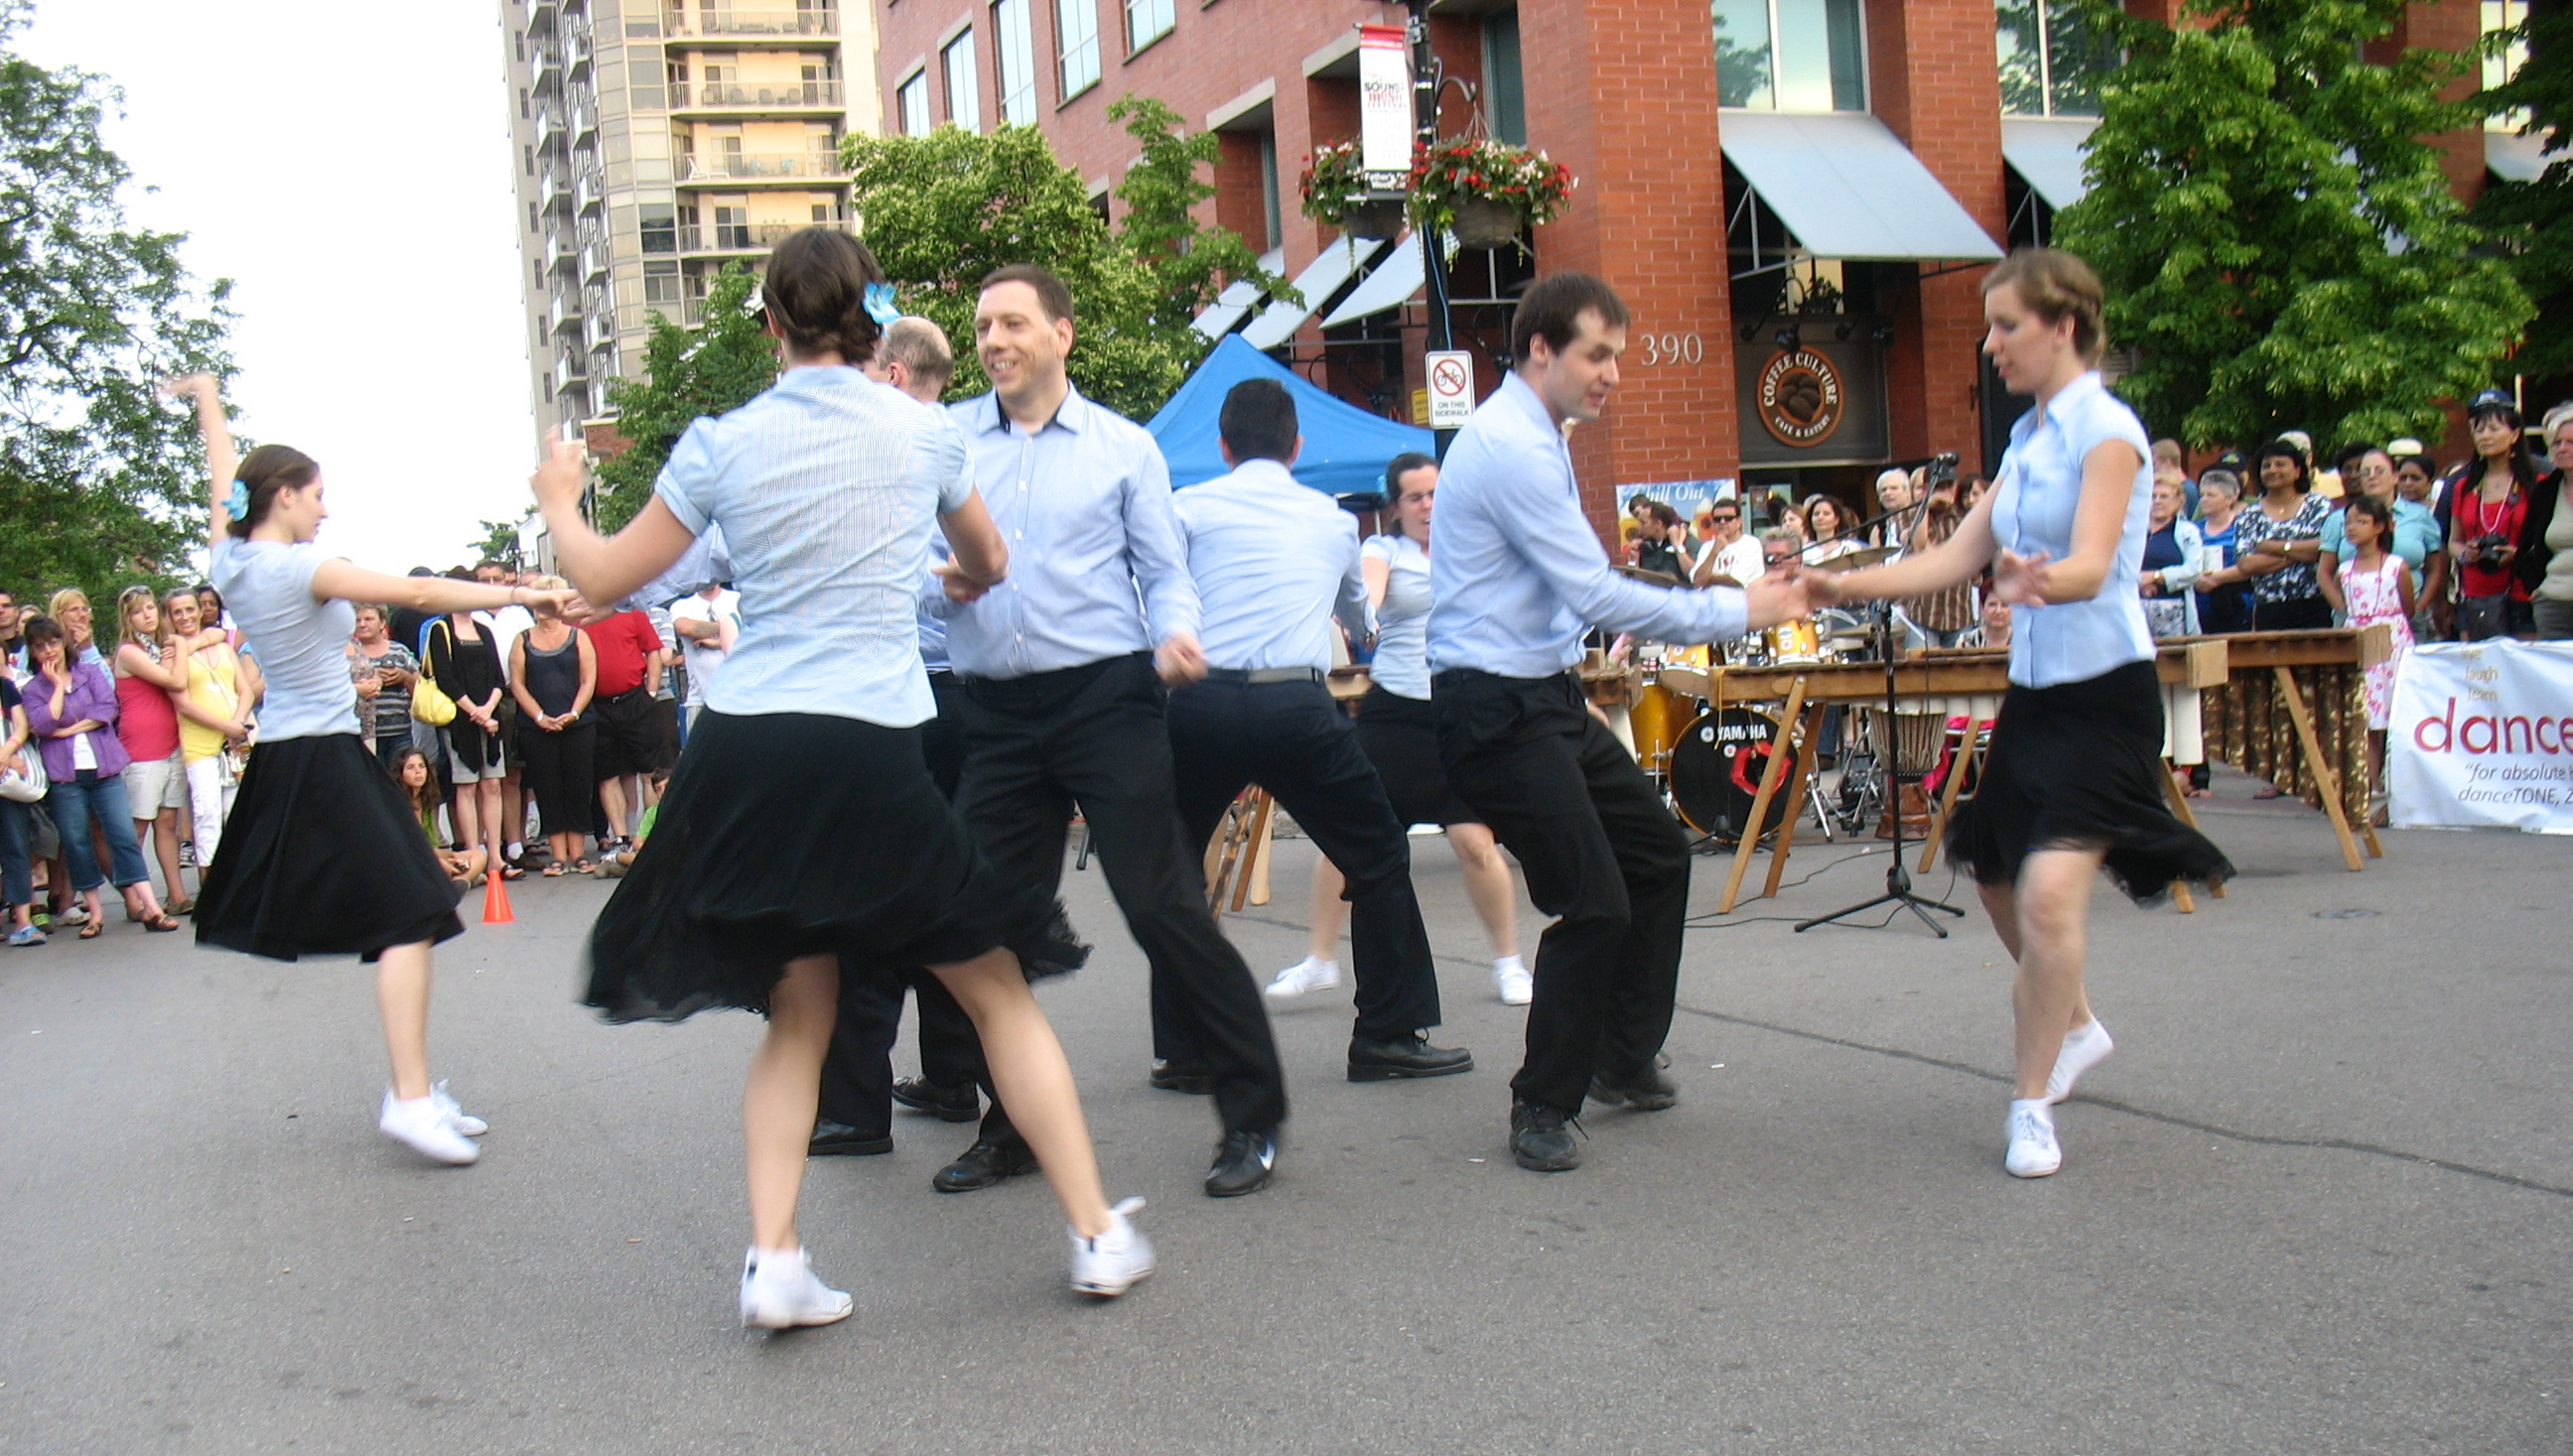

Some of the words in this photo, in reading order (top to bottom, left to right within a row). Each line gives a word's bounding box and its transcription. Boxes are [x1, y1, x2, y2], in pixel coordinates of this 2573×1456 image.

[1640, 333, 1702, 366] 390
[1763, 354, 1794, 407] COFFEE
[1795, 352, 1837, 405] CULTURE
[1675, 484, 1704, 501] Out
[2466, 666, 2499, 683] laugh
[2469, 688, 2498, 701] learn
[2502, 763, 2566, 781] absolute
[2458, 785, 2560, 807] danceTONE,
